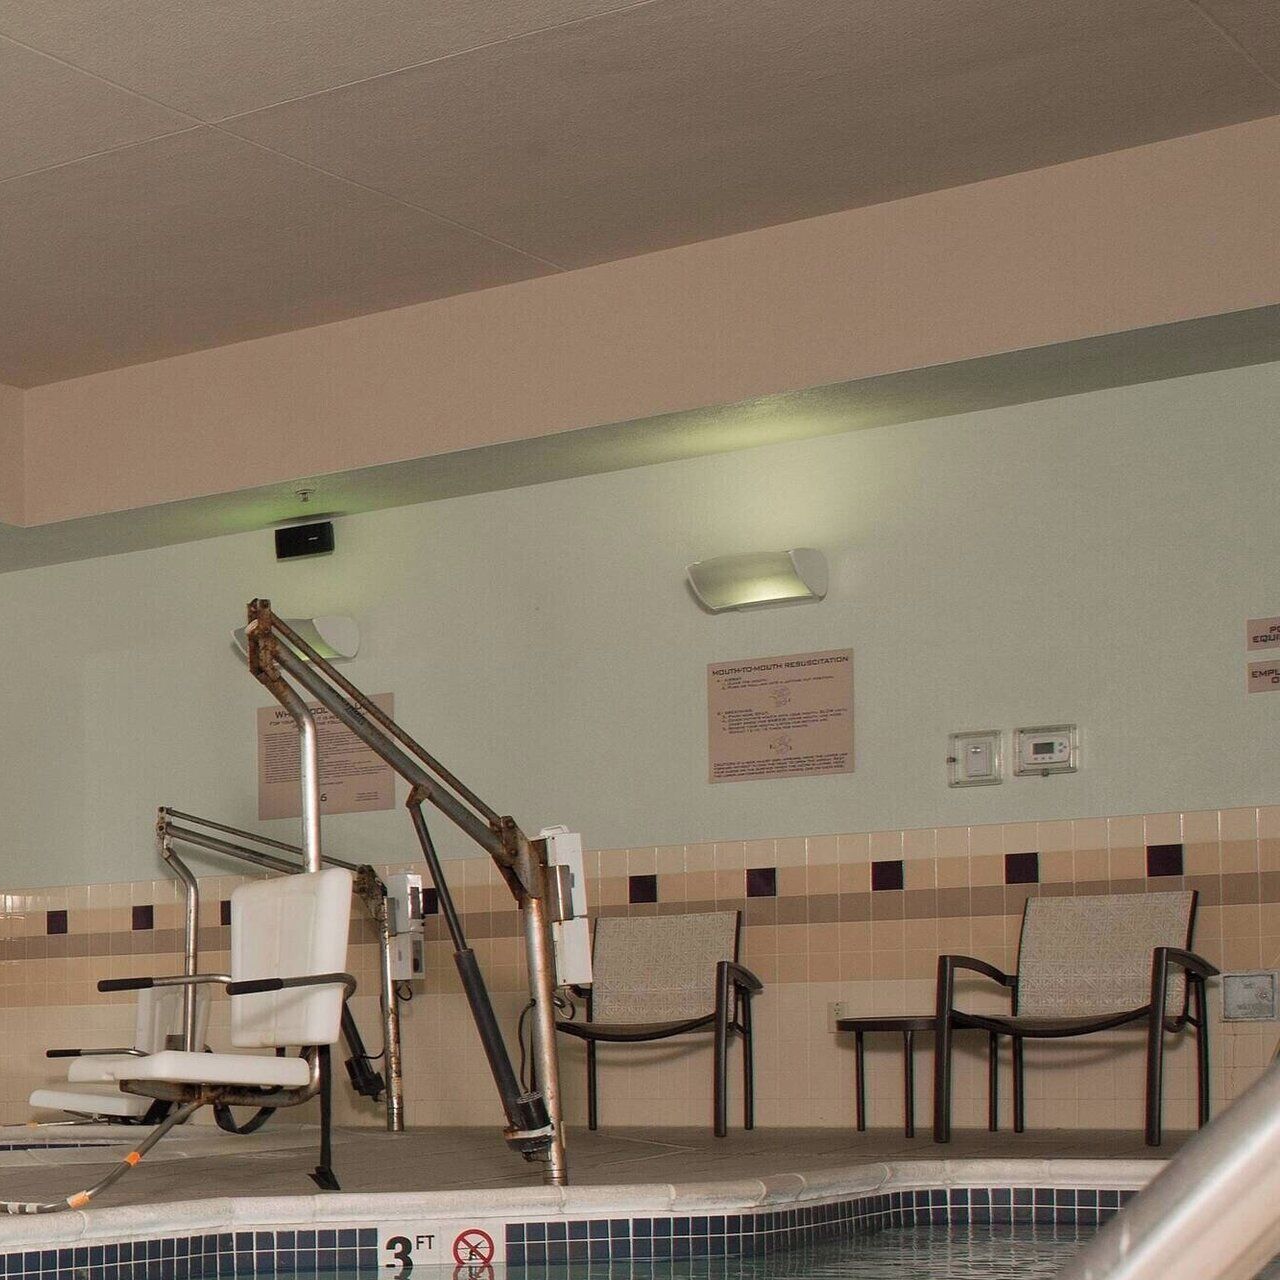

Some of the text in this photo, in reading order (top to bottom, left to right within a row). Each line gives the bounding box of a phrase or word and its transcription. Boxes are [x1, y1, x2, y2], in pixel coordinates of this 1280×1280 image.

[712, 656, 849, 676] MOUTH-TO-MOUTH RESUSCITATION
[386, 1235, 435, 1268] 3 FT
